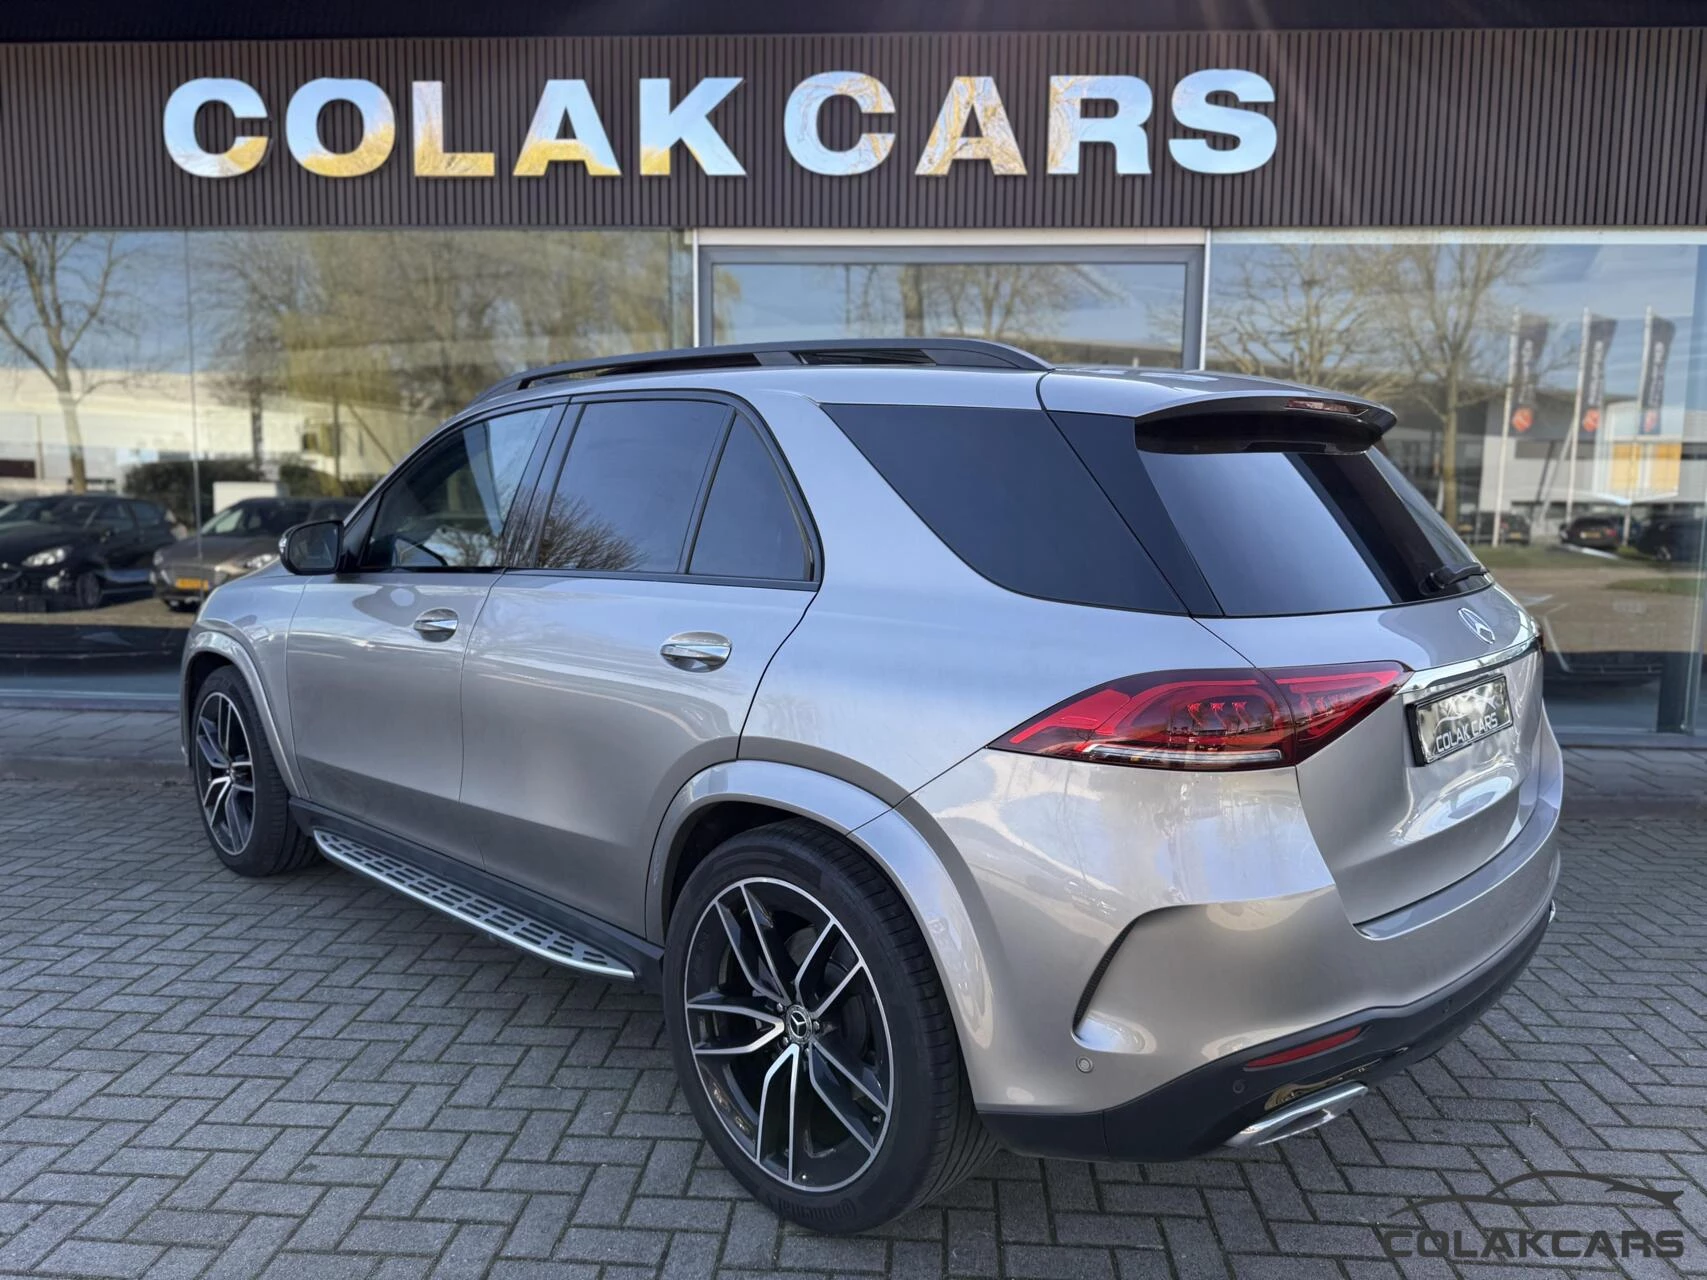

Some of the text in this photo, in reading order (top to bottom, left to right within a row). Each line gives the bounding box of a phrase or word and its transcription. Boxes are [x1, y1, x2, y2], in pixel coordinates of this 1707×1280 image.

[163, 68, 1278, 178] COLAK CARS
[1436, 713, 1498, 753] COLAK CARS
